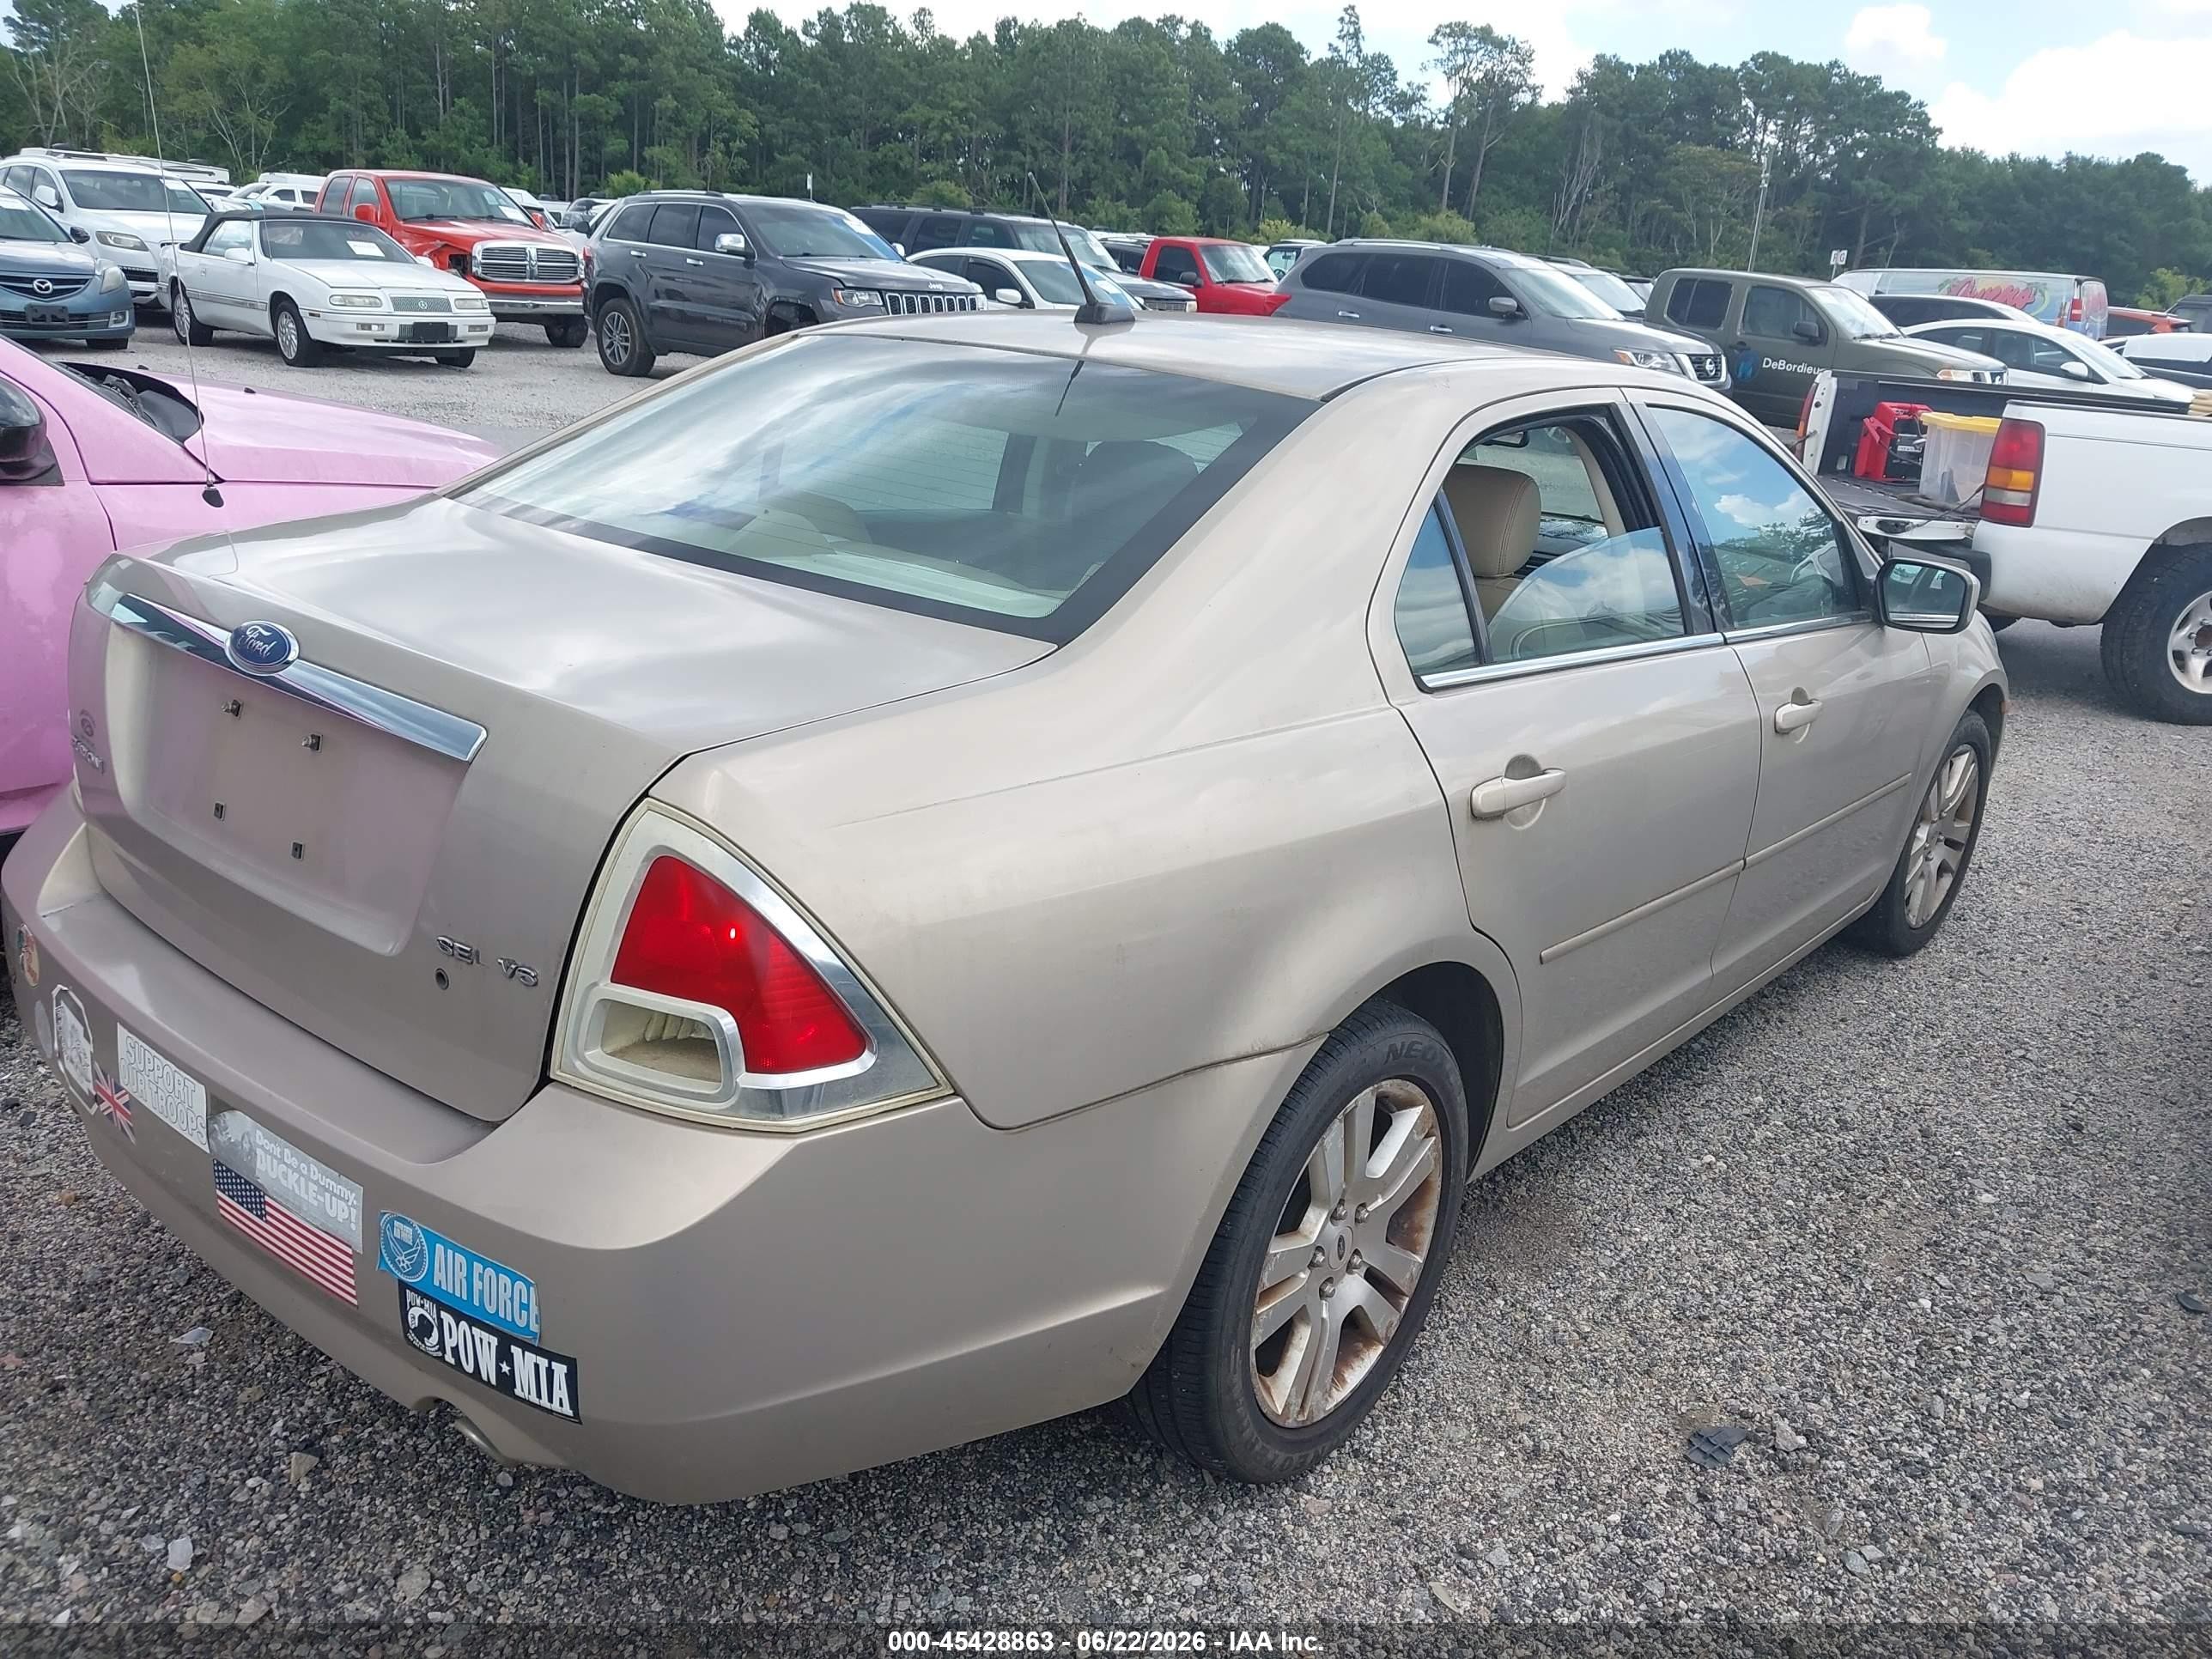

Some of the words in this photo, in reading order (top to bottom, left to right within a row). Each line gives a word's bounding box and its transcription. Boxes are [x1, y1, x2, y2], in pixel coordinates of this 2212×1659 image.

[236, 625, 277, 659] Ford
[497, 957, 538, 987] V6
[120, 1058, 148, 1103] OUR
[149, 1079, 208, 1146] TROOPS
[126, 1036, 196, 1109] SUPPORT
[255, 1148, 357, 1231] BUCKLE-UP!
[256, 1129, 282, 1158] Don't
[300, 1163, 309, 1176] a
[434, 1243, 468, 1301] AIR
[473, 1261, 541, 1334] FORCE
[441, 1310, 498, 1387] POW
[511, 1344, 574, 1417] MIA
